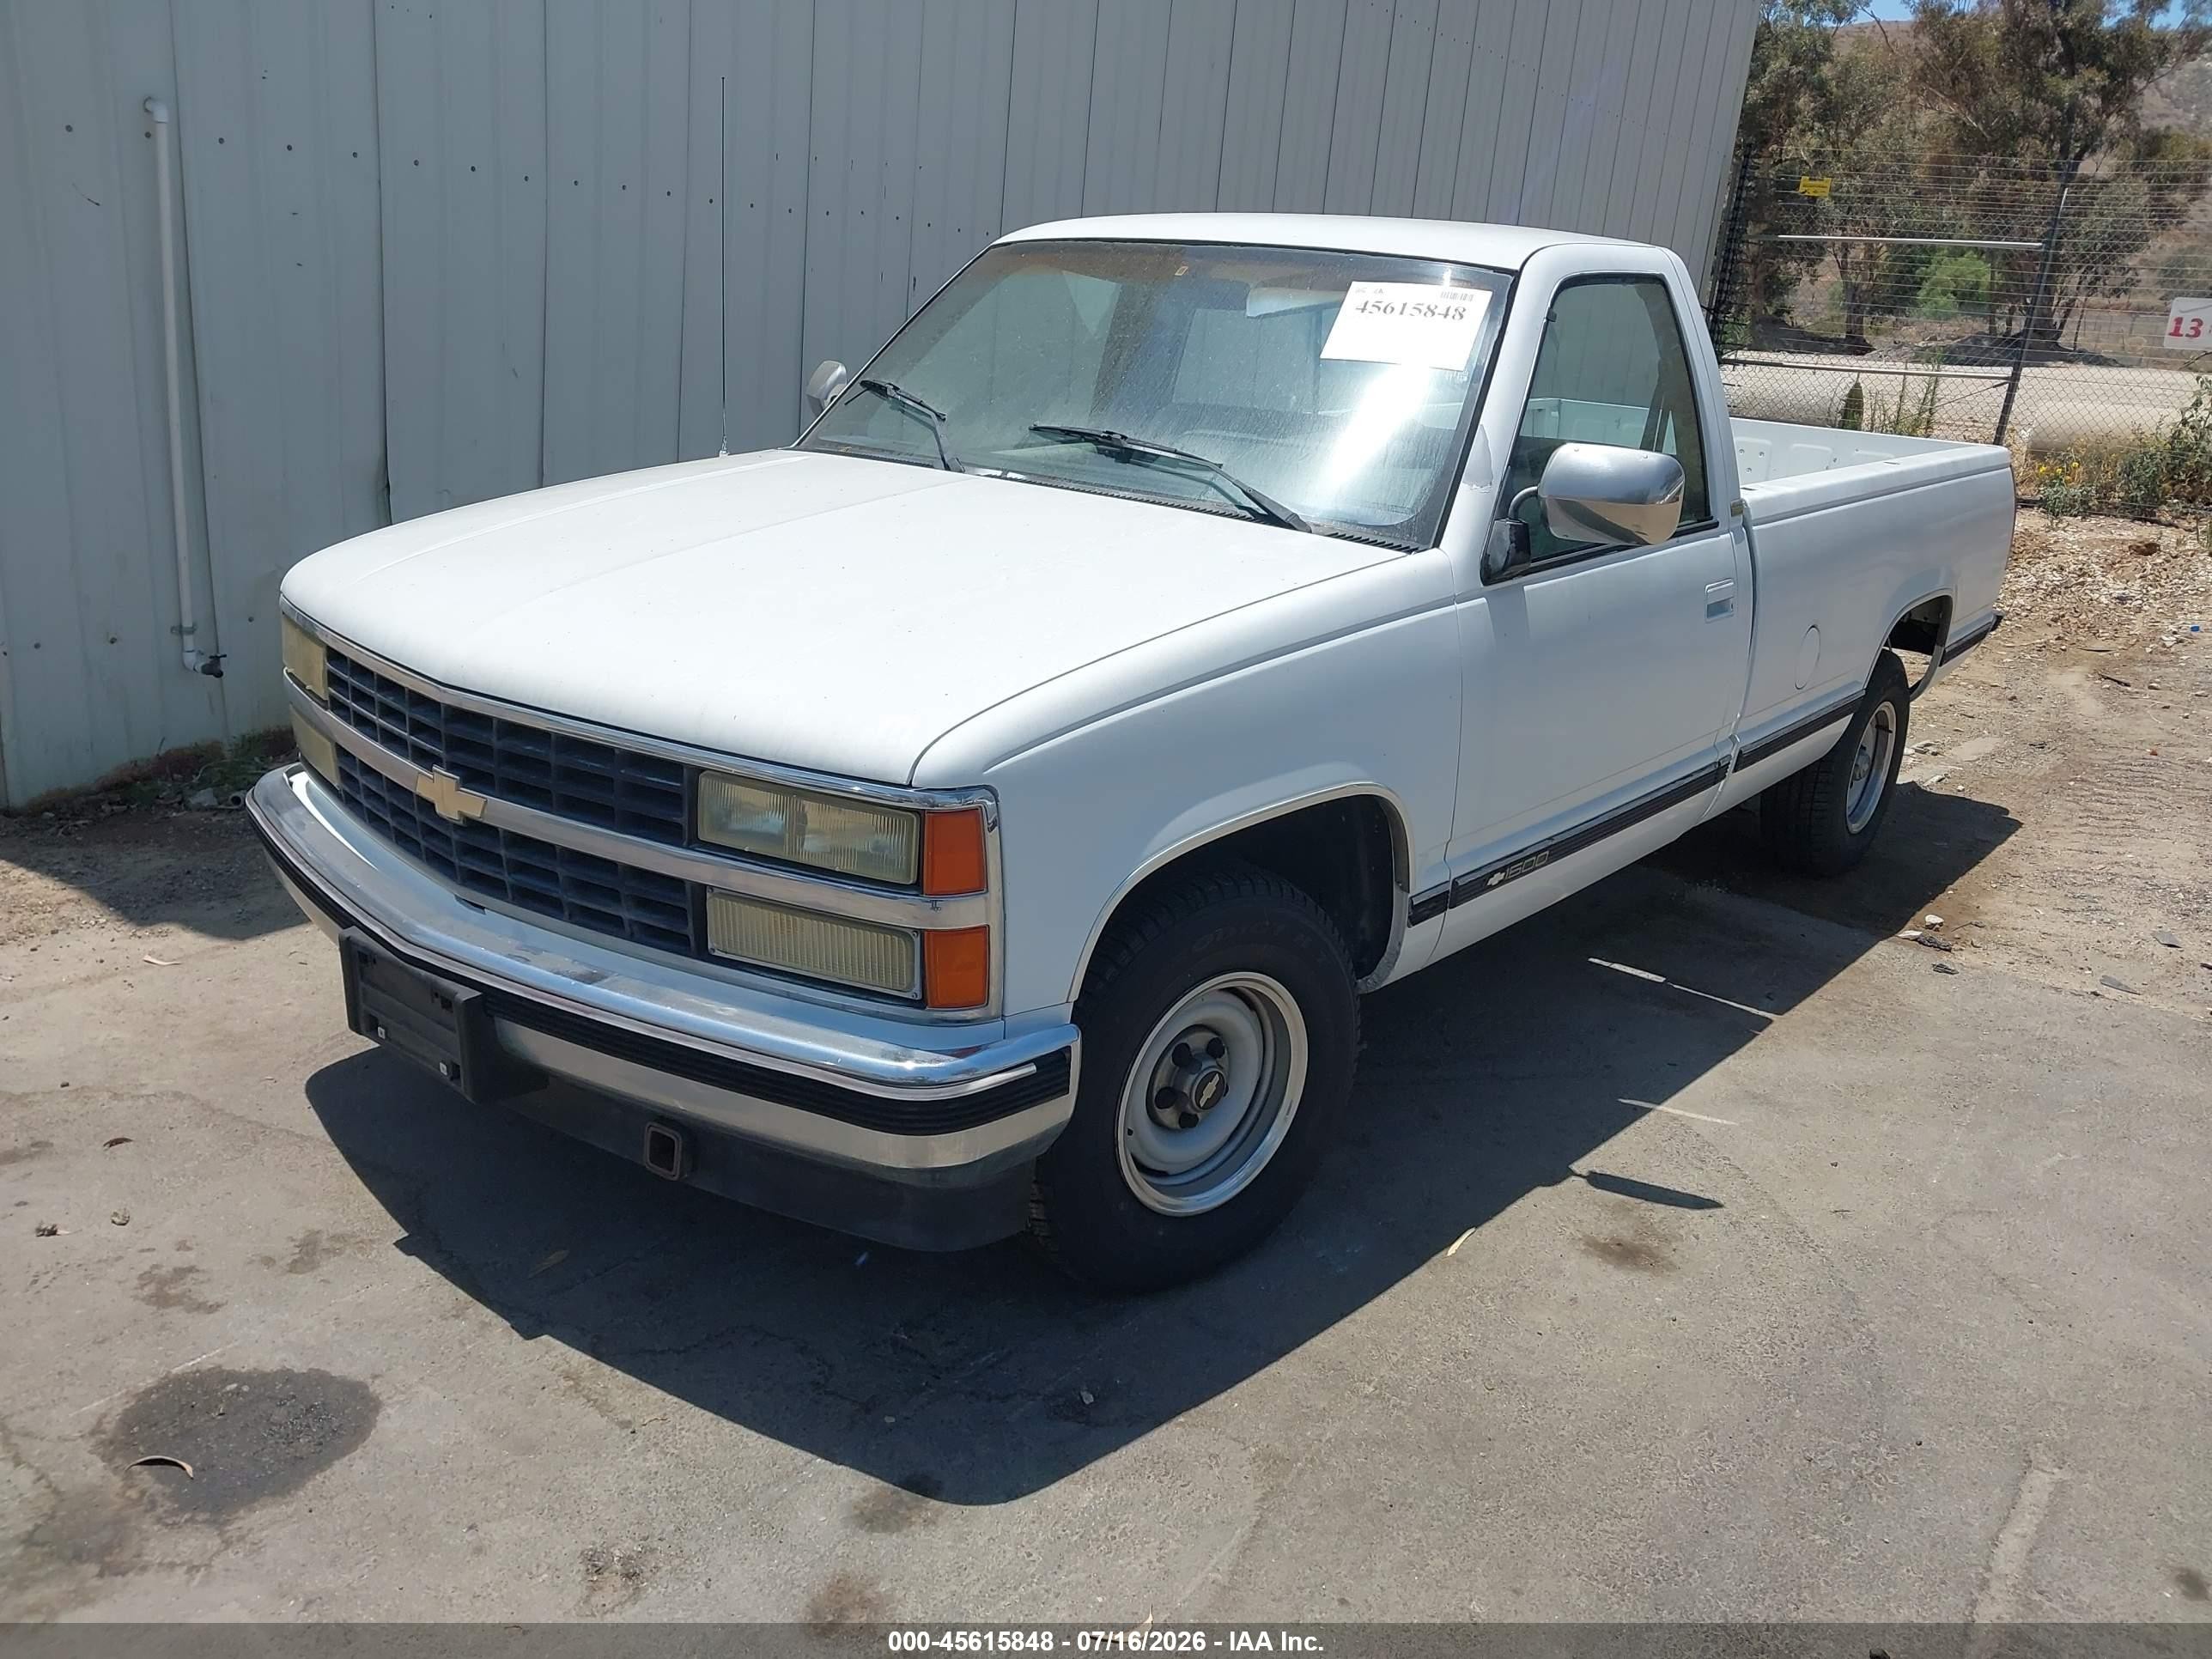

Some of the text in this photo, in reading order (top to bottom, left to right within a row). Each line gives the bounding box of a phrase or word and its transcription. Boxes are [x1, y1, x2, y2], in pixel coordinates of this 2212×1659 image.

[1354, 299, 1467, 321] 45615848
[2168, 316, 2204, 338] 13
[1504, 850, 1550, 879] 1500
